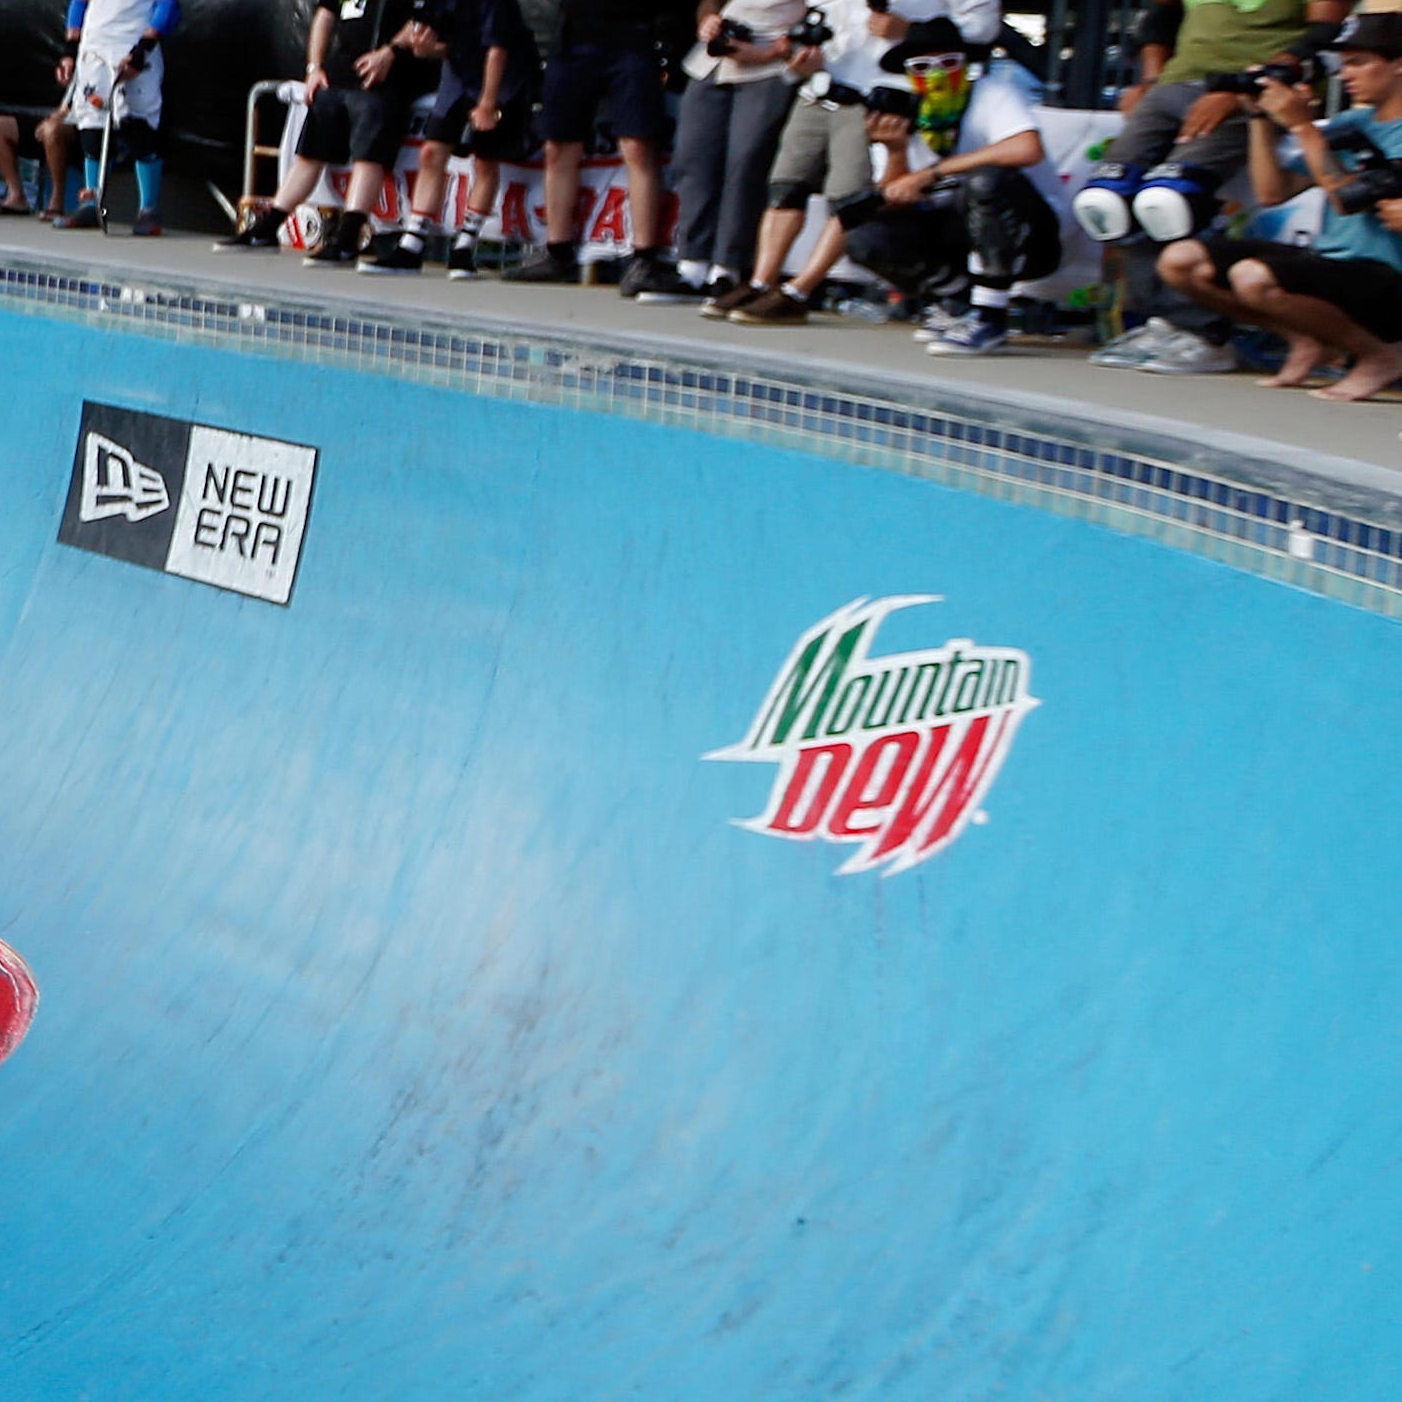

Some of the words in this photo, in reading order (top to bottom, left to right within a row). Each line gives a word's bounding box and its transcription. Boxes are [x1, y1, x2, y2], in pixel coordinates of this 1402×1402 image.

[201, 462, 293, 518] NEW
[194, 506, 285, 566] ERA
[749, 616, 1020, 750] Mountain
